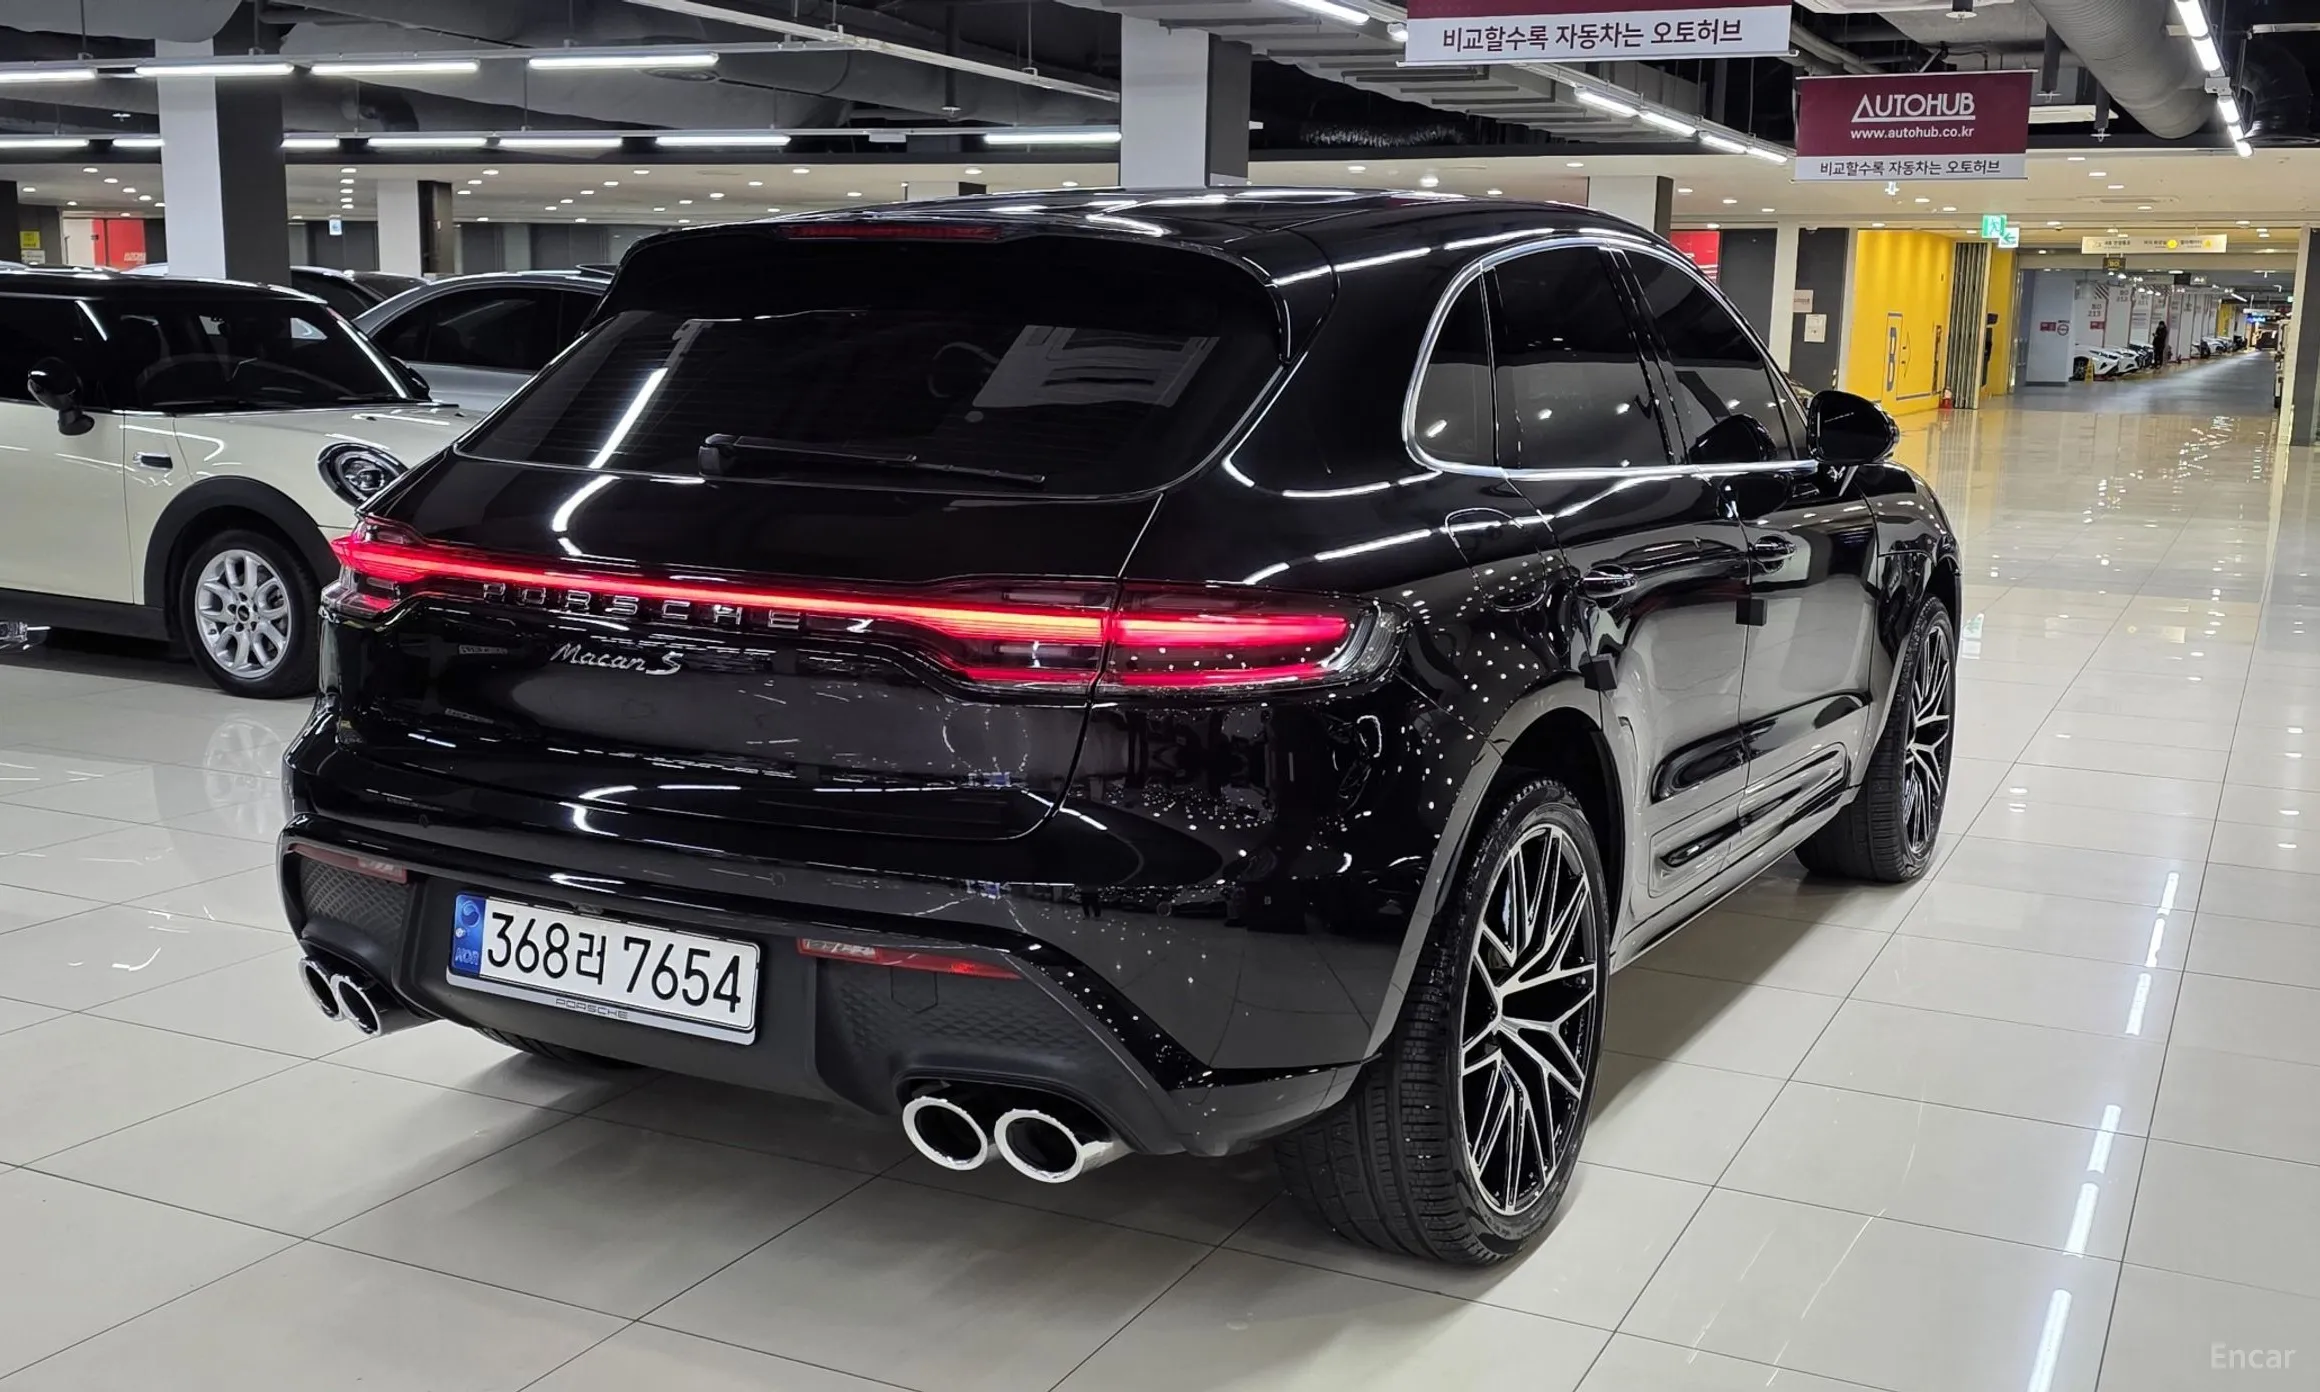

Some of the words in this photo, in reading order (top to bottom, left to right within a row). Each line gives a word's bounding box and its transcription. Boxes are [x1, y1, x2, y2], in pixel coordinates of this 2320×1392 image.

[1443, 26, 1549, 52] 비교할수록
[1555, 22, 1645, 48] 자동차는
[1651, 19, 1744, 44] 오토허브
[1851, 92, 1976, 122] AUTOHUB
[1851, 126, 1975, 139] www.autohub.co.kr
[1820, 161, 1885, 176] 비교할수록
[1888, 160, 1942, 175] 자동차는
[1946, 159, 2001, 174] 오토허브
[483, 583, 801, 629] PORSCHE
[550, 642, 645, 671] Macan
[645, 651, 684, 675] S
[487, 912, 607, 985] 368러
[623, 936, 741, 1013] 7654
[555, 998, 629, 1020] PORSCHE
